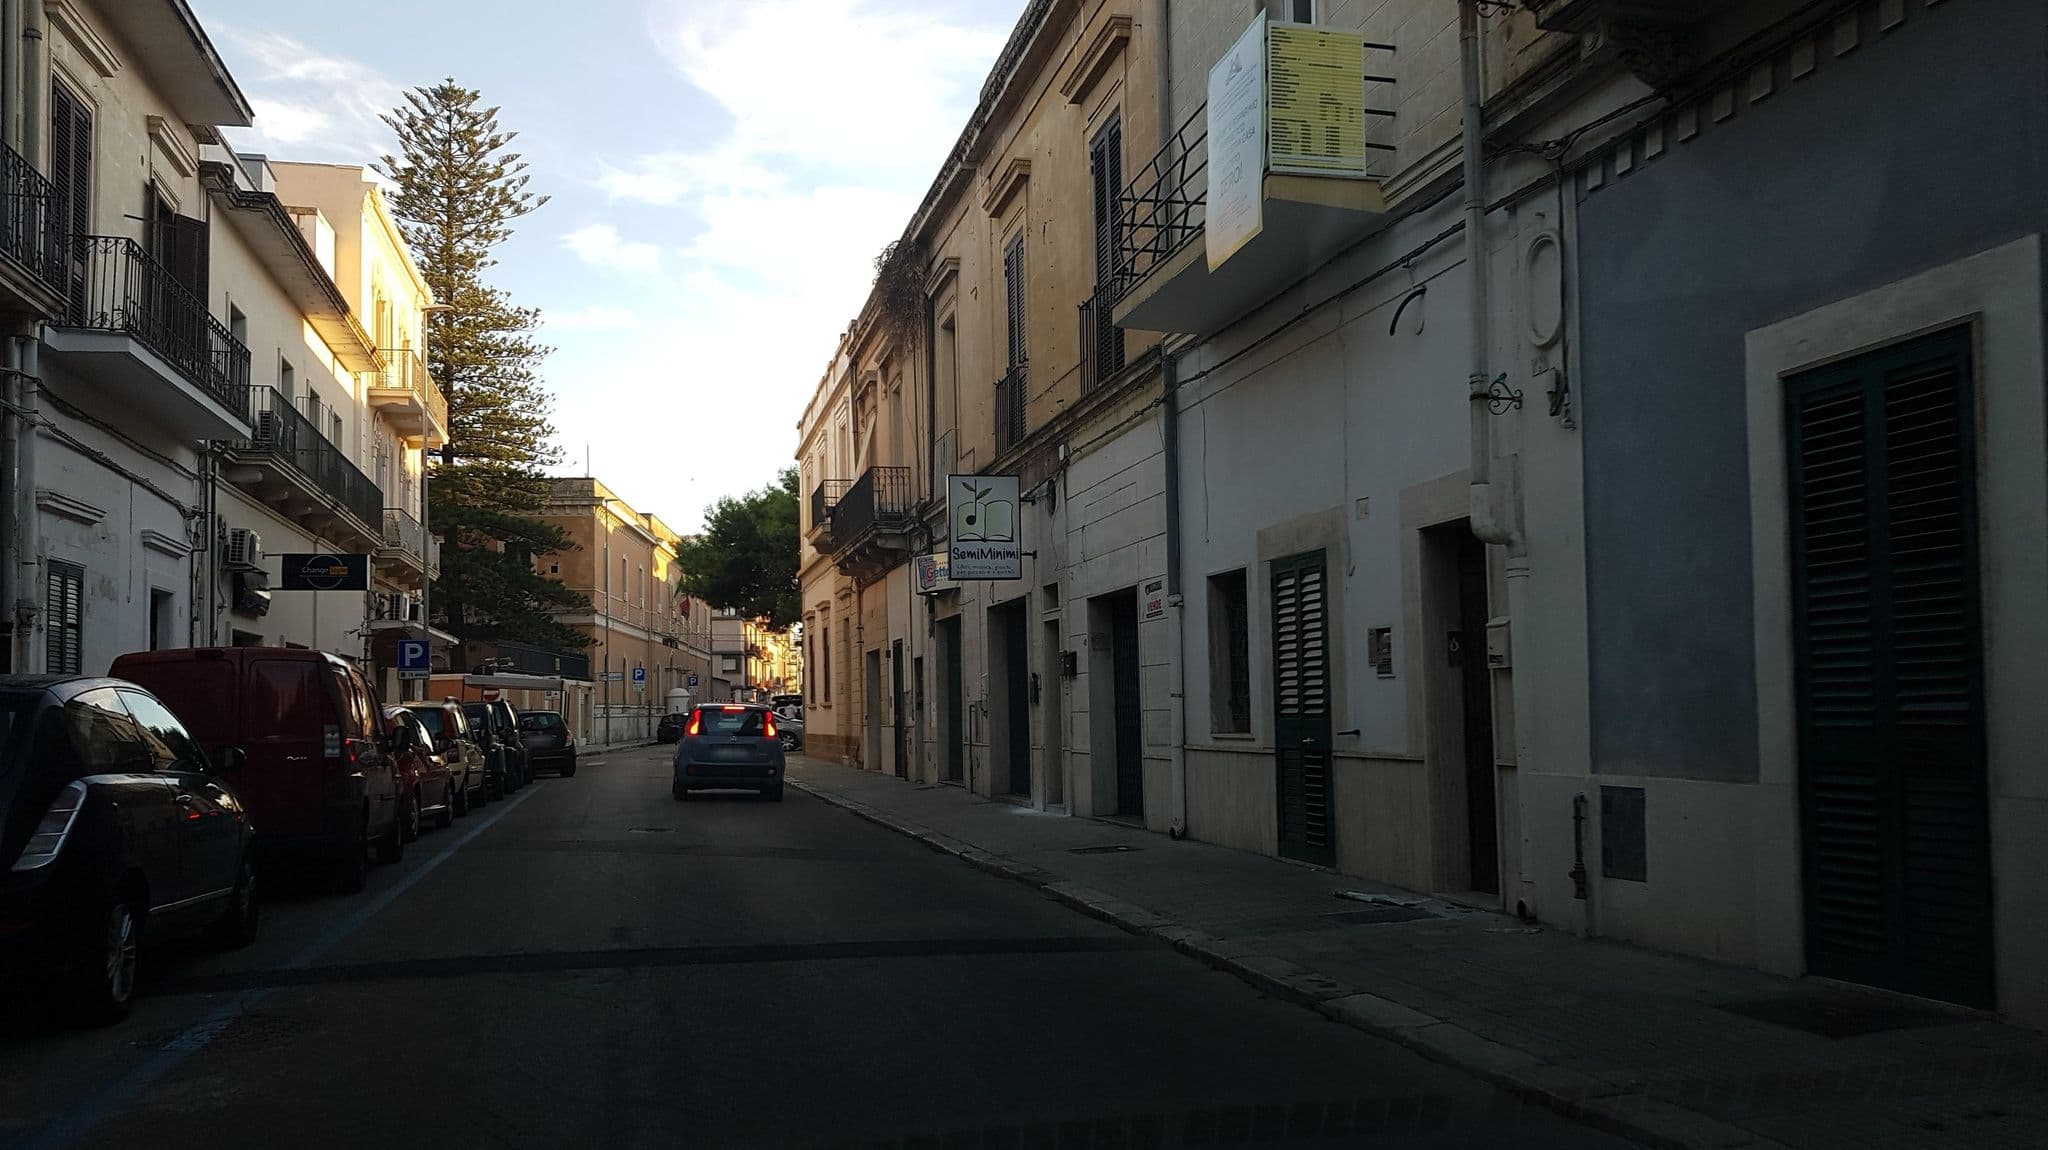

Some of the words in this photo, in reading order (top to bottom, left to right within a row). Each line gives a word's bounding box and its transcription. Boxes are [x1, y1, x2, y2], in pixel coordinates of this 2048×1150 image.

[952, 547, 1019, 561] SemiMinimi
[301, 565, 329, 575] Change
[404, 643, 423, 667] P
[635, 669, 643, 680] P
[690, 677, 697, 685] P
